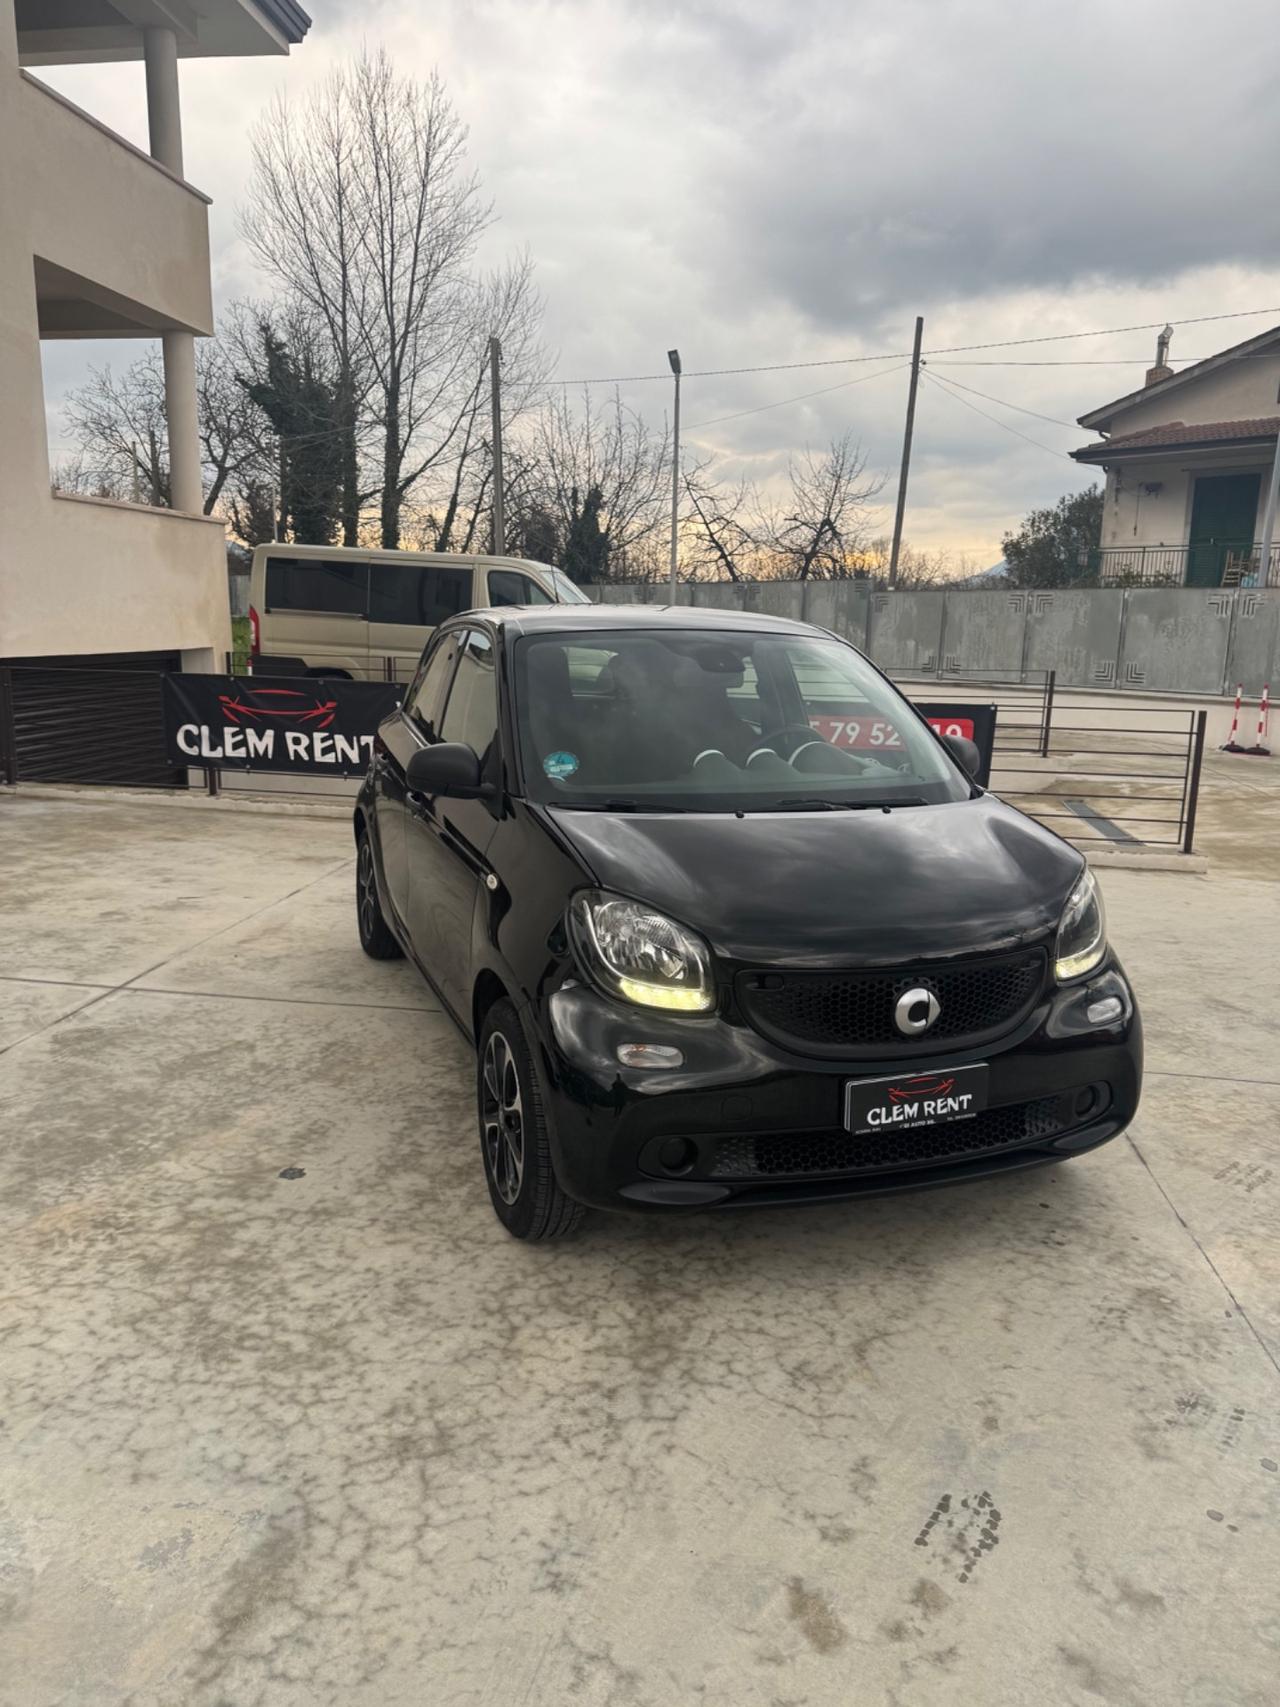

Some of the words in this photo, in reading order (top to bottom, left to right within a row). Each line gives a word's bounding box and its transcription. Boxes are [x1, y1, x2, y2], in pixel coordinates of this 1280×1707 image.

[176, 724, 274, 760] CLEM
[285, 731, 375, 764] RENT
[829, 721, 860, 745] 79
[866, 1102, 919, 1126] CLEM
[923, 1094, 972, 1117] RENT
